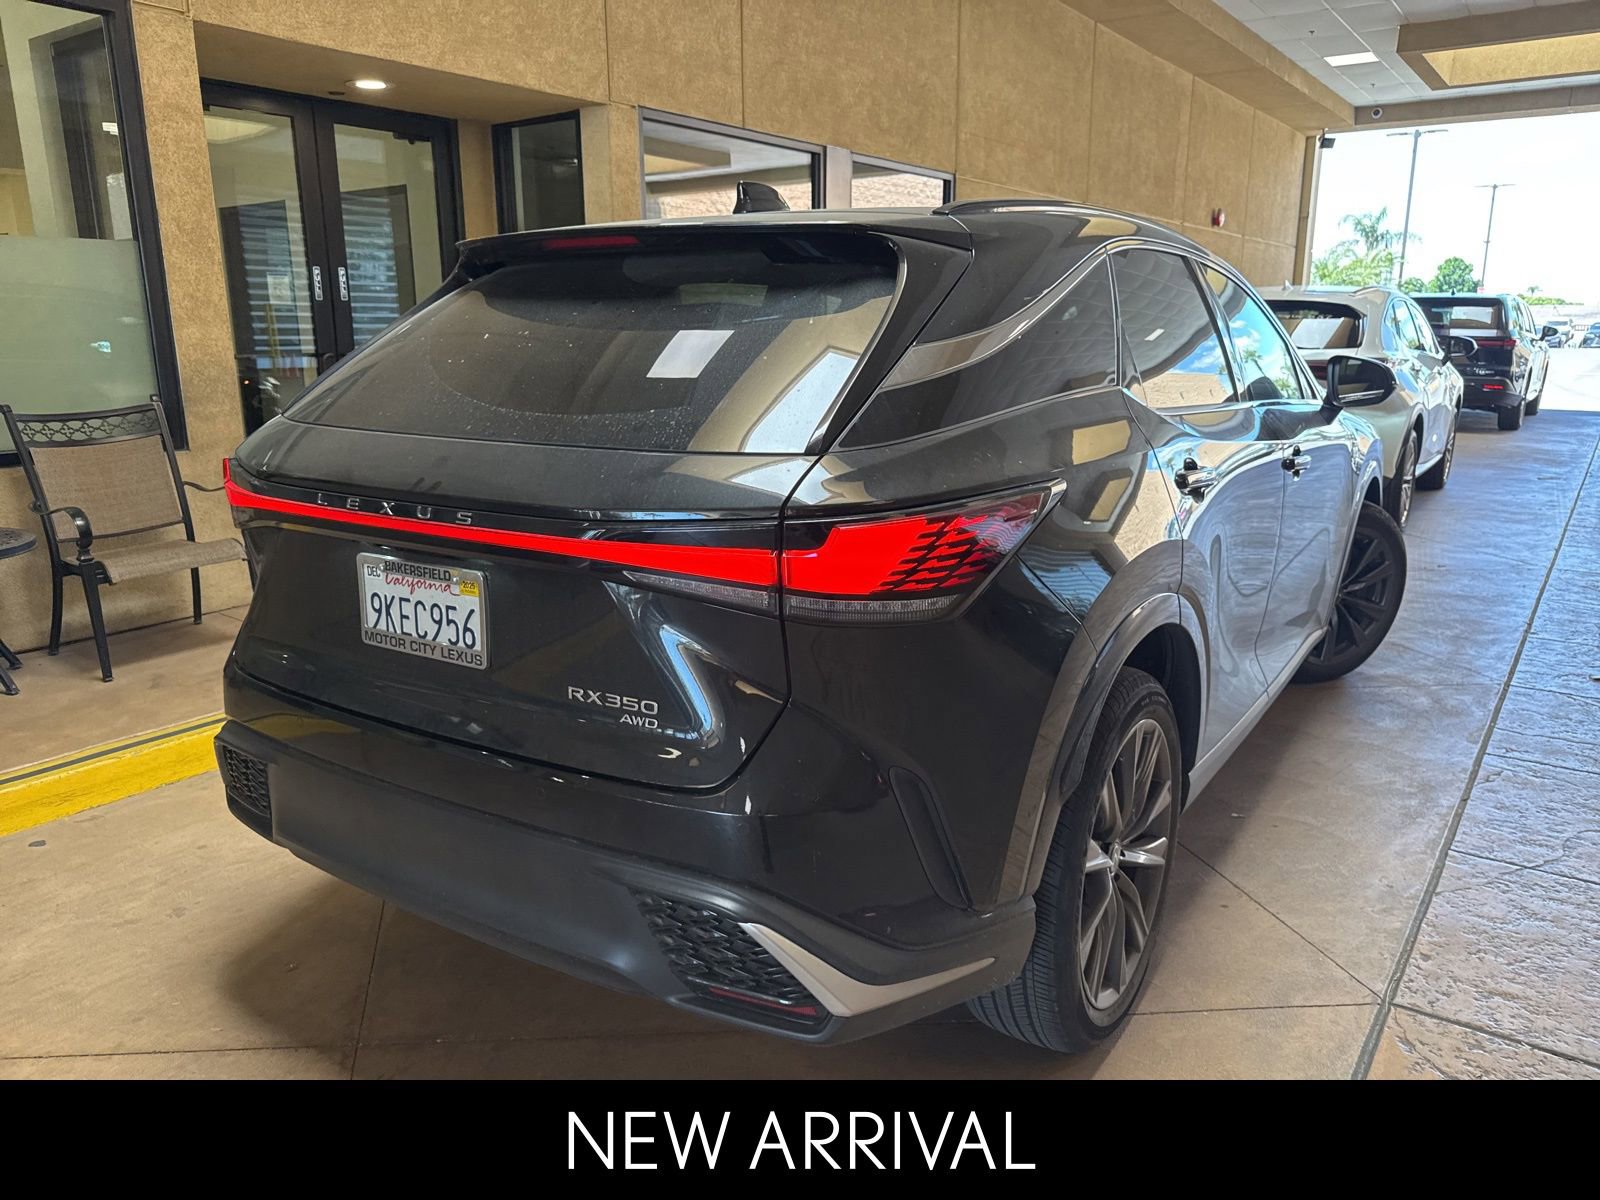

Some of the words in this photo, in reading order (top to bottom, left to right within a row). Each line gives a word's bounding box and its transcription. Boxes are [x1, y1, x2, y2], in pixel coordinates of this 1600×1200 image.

[317, 493, 473, 525] LEXUS
[366, 565, 381, 578] DEC
[384, 560, 451, 582] BAKERSFIELD
[385, 572, 461, 597] California
[370, 592, 477, 650] 9KEC956
[364, 630, 406, 650] MOTOR
[410, 640, 437, 656] CITY
[441, 647, 483, 667] LEXUS
[567, 686, 659, 715] RX350
[619, 713, 659, 729] AWD
